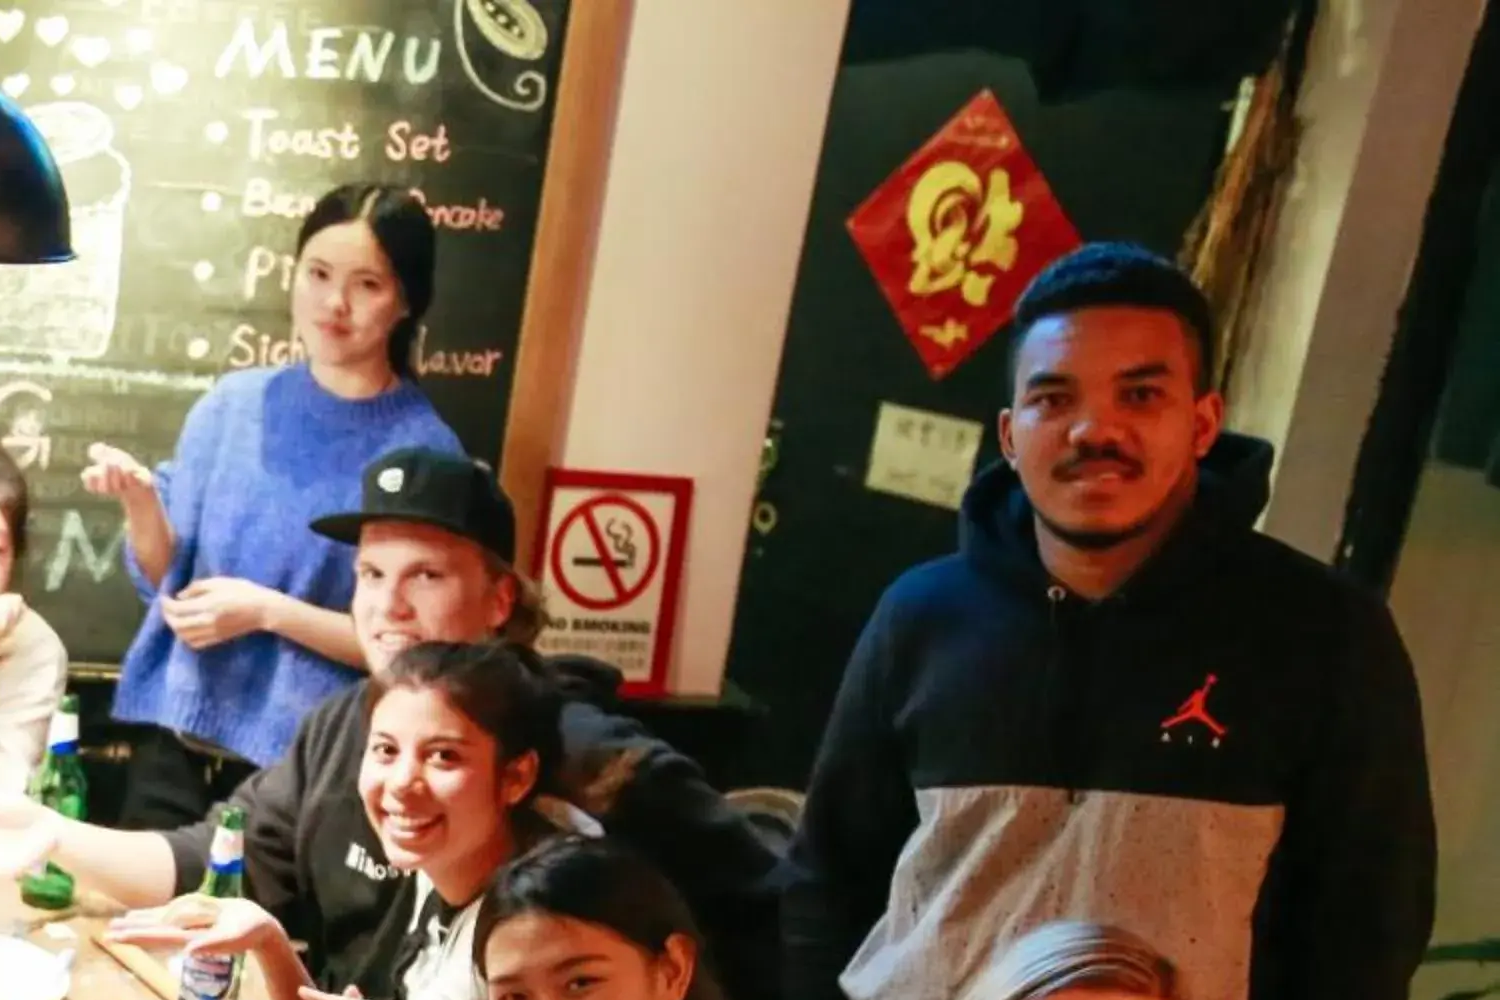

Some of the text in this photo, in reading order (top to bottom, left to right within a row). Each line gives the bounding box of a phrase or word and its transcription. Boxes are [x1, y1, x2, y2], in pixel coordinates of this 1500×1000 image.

[214, 16, 442, 85] MENU
[240, 107, 451, 162] Toast Set
